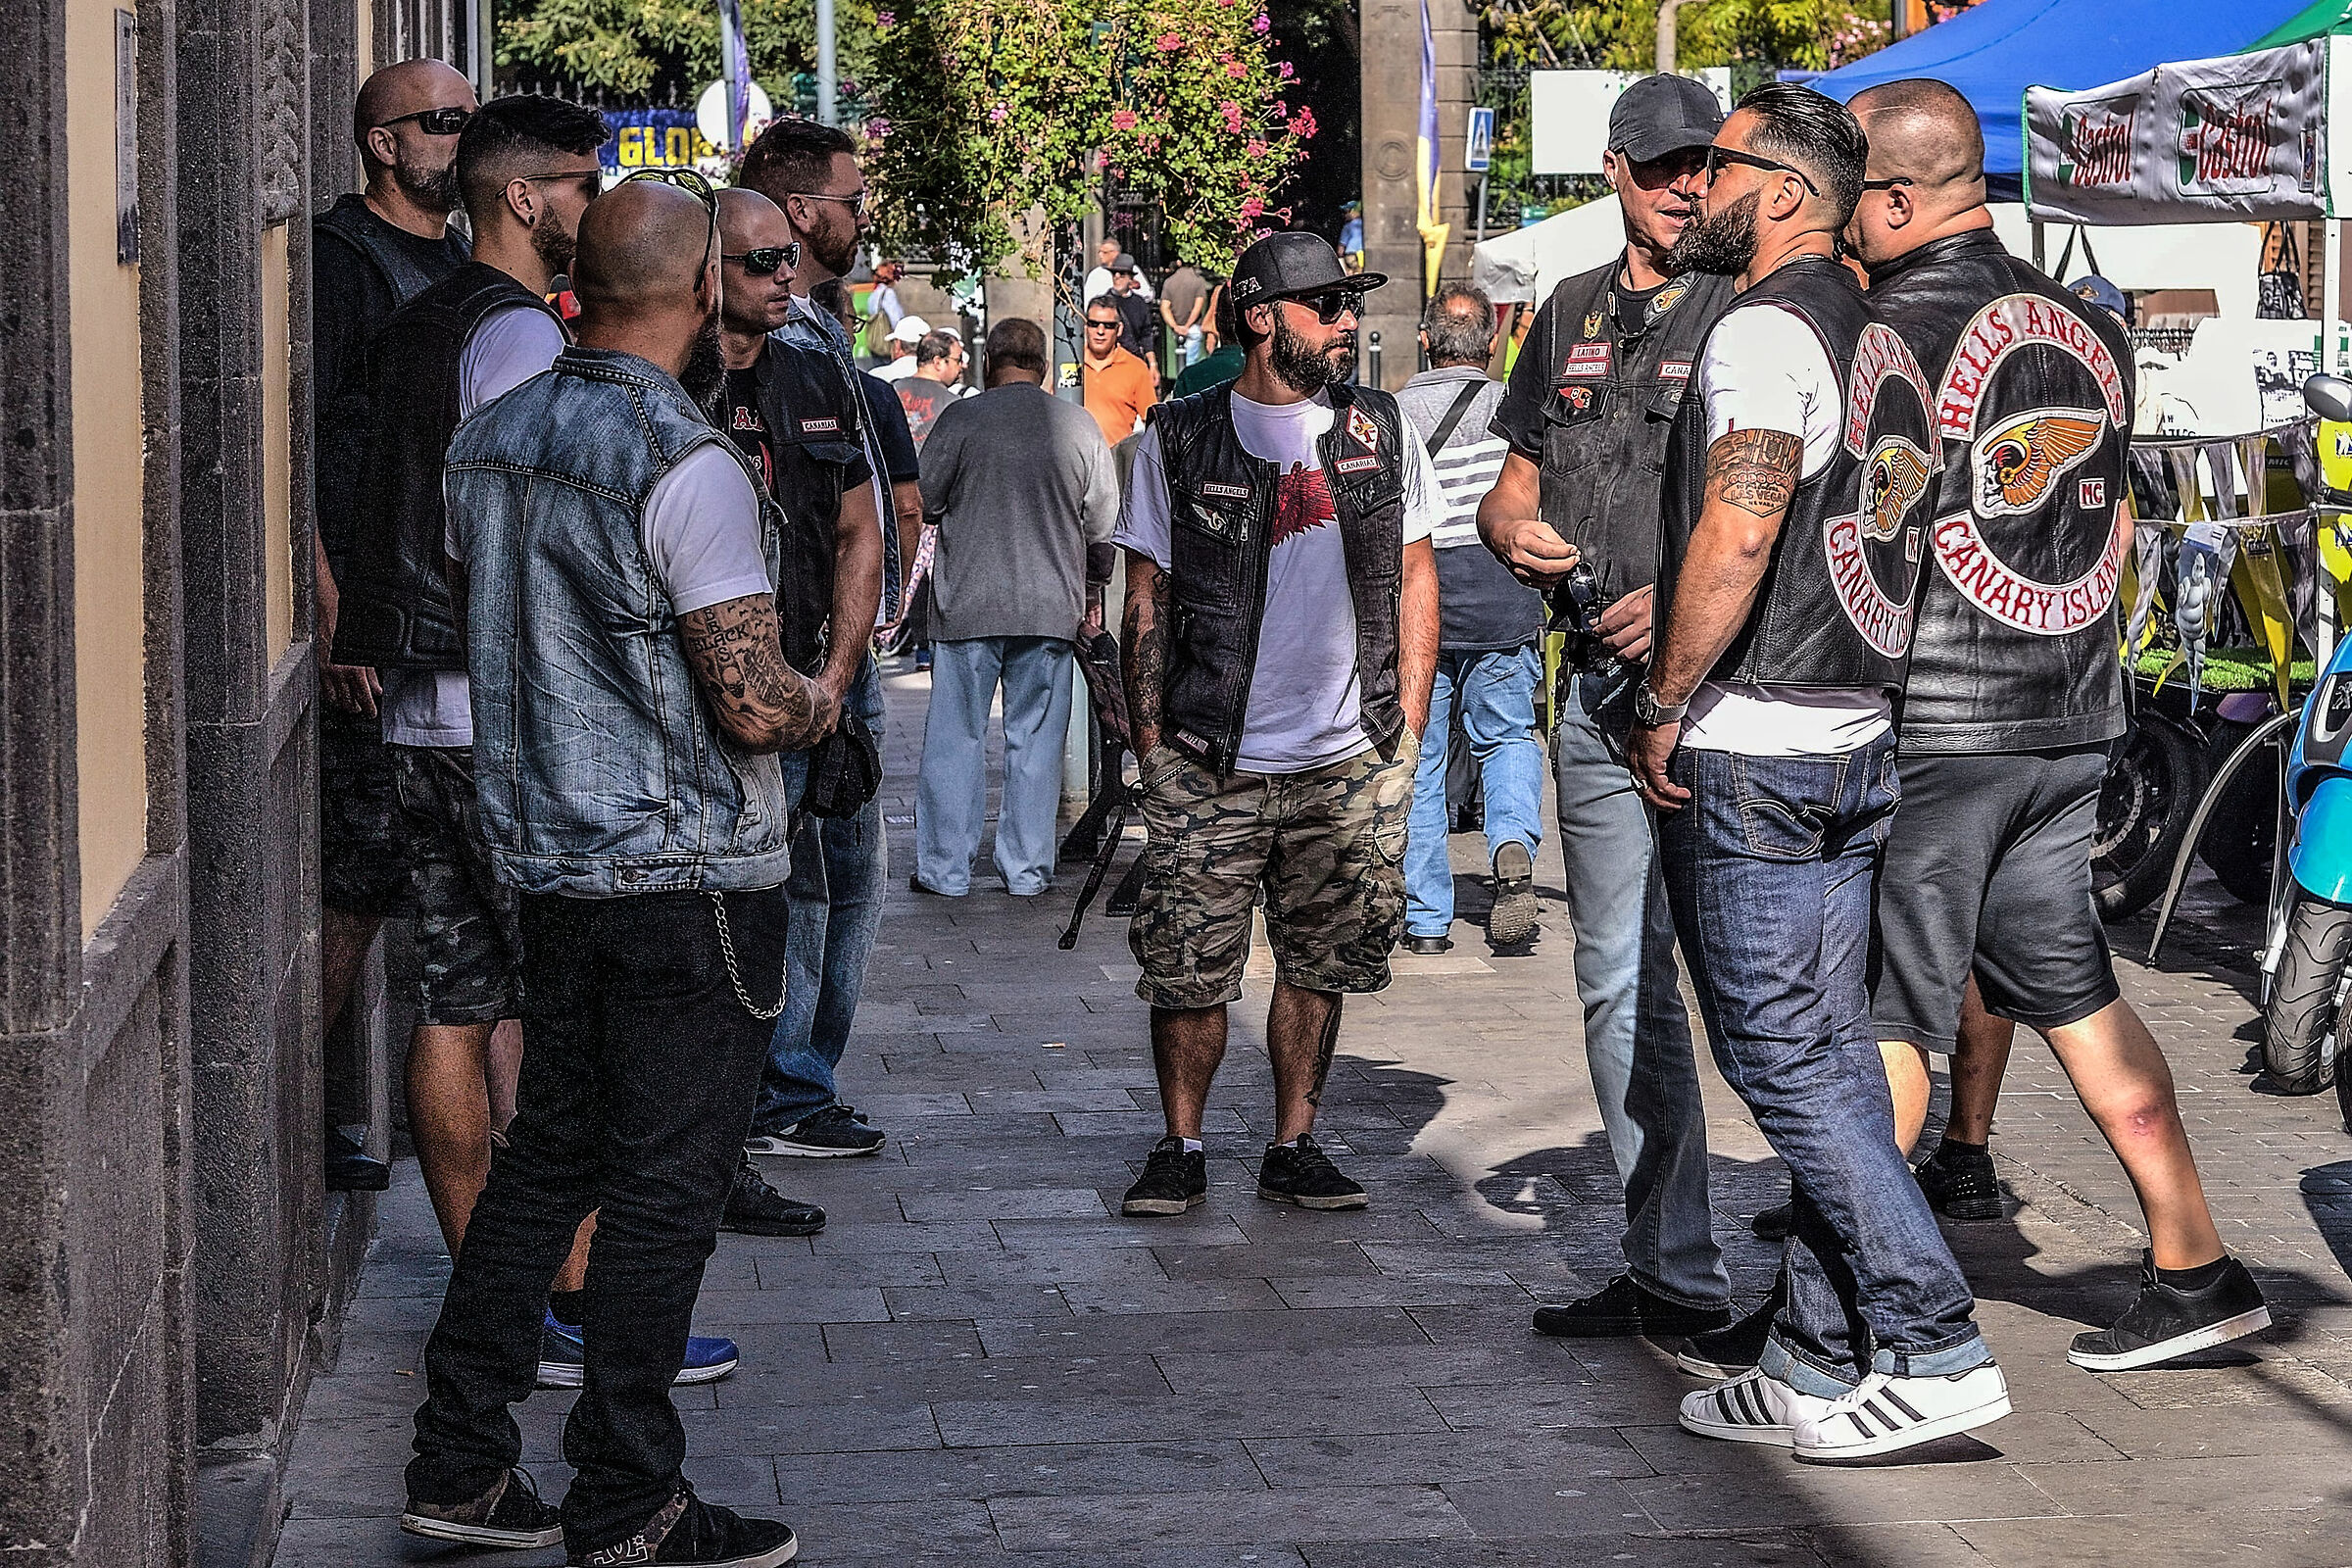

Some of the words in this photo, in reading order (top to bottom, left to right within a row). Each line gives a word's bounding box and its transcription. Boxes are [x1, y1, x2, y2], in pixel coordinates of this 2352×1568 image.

[2074, 109, 2134, 187] Castrol
[2198, 98, 2273, 181] Castrol
[1577, 347, 1600, 358] LATINO
[1939, 308, 2014, 433] HELLS
[2025, 299, 2125, 421] ANGELS
[805, 418, 837, 430] CANARIAS
[1341, 458, 1375, 470] CANARIAS
[2082, 483, 2104, 506] MC
[1829, 521, 1896, 651] CANARY
[1935, 520, 2055, 629] CANARY
